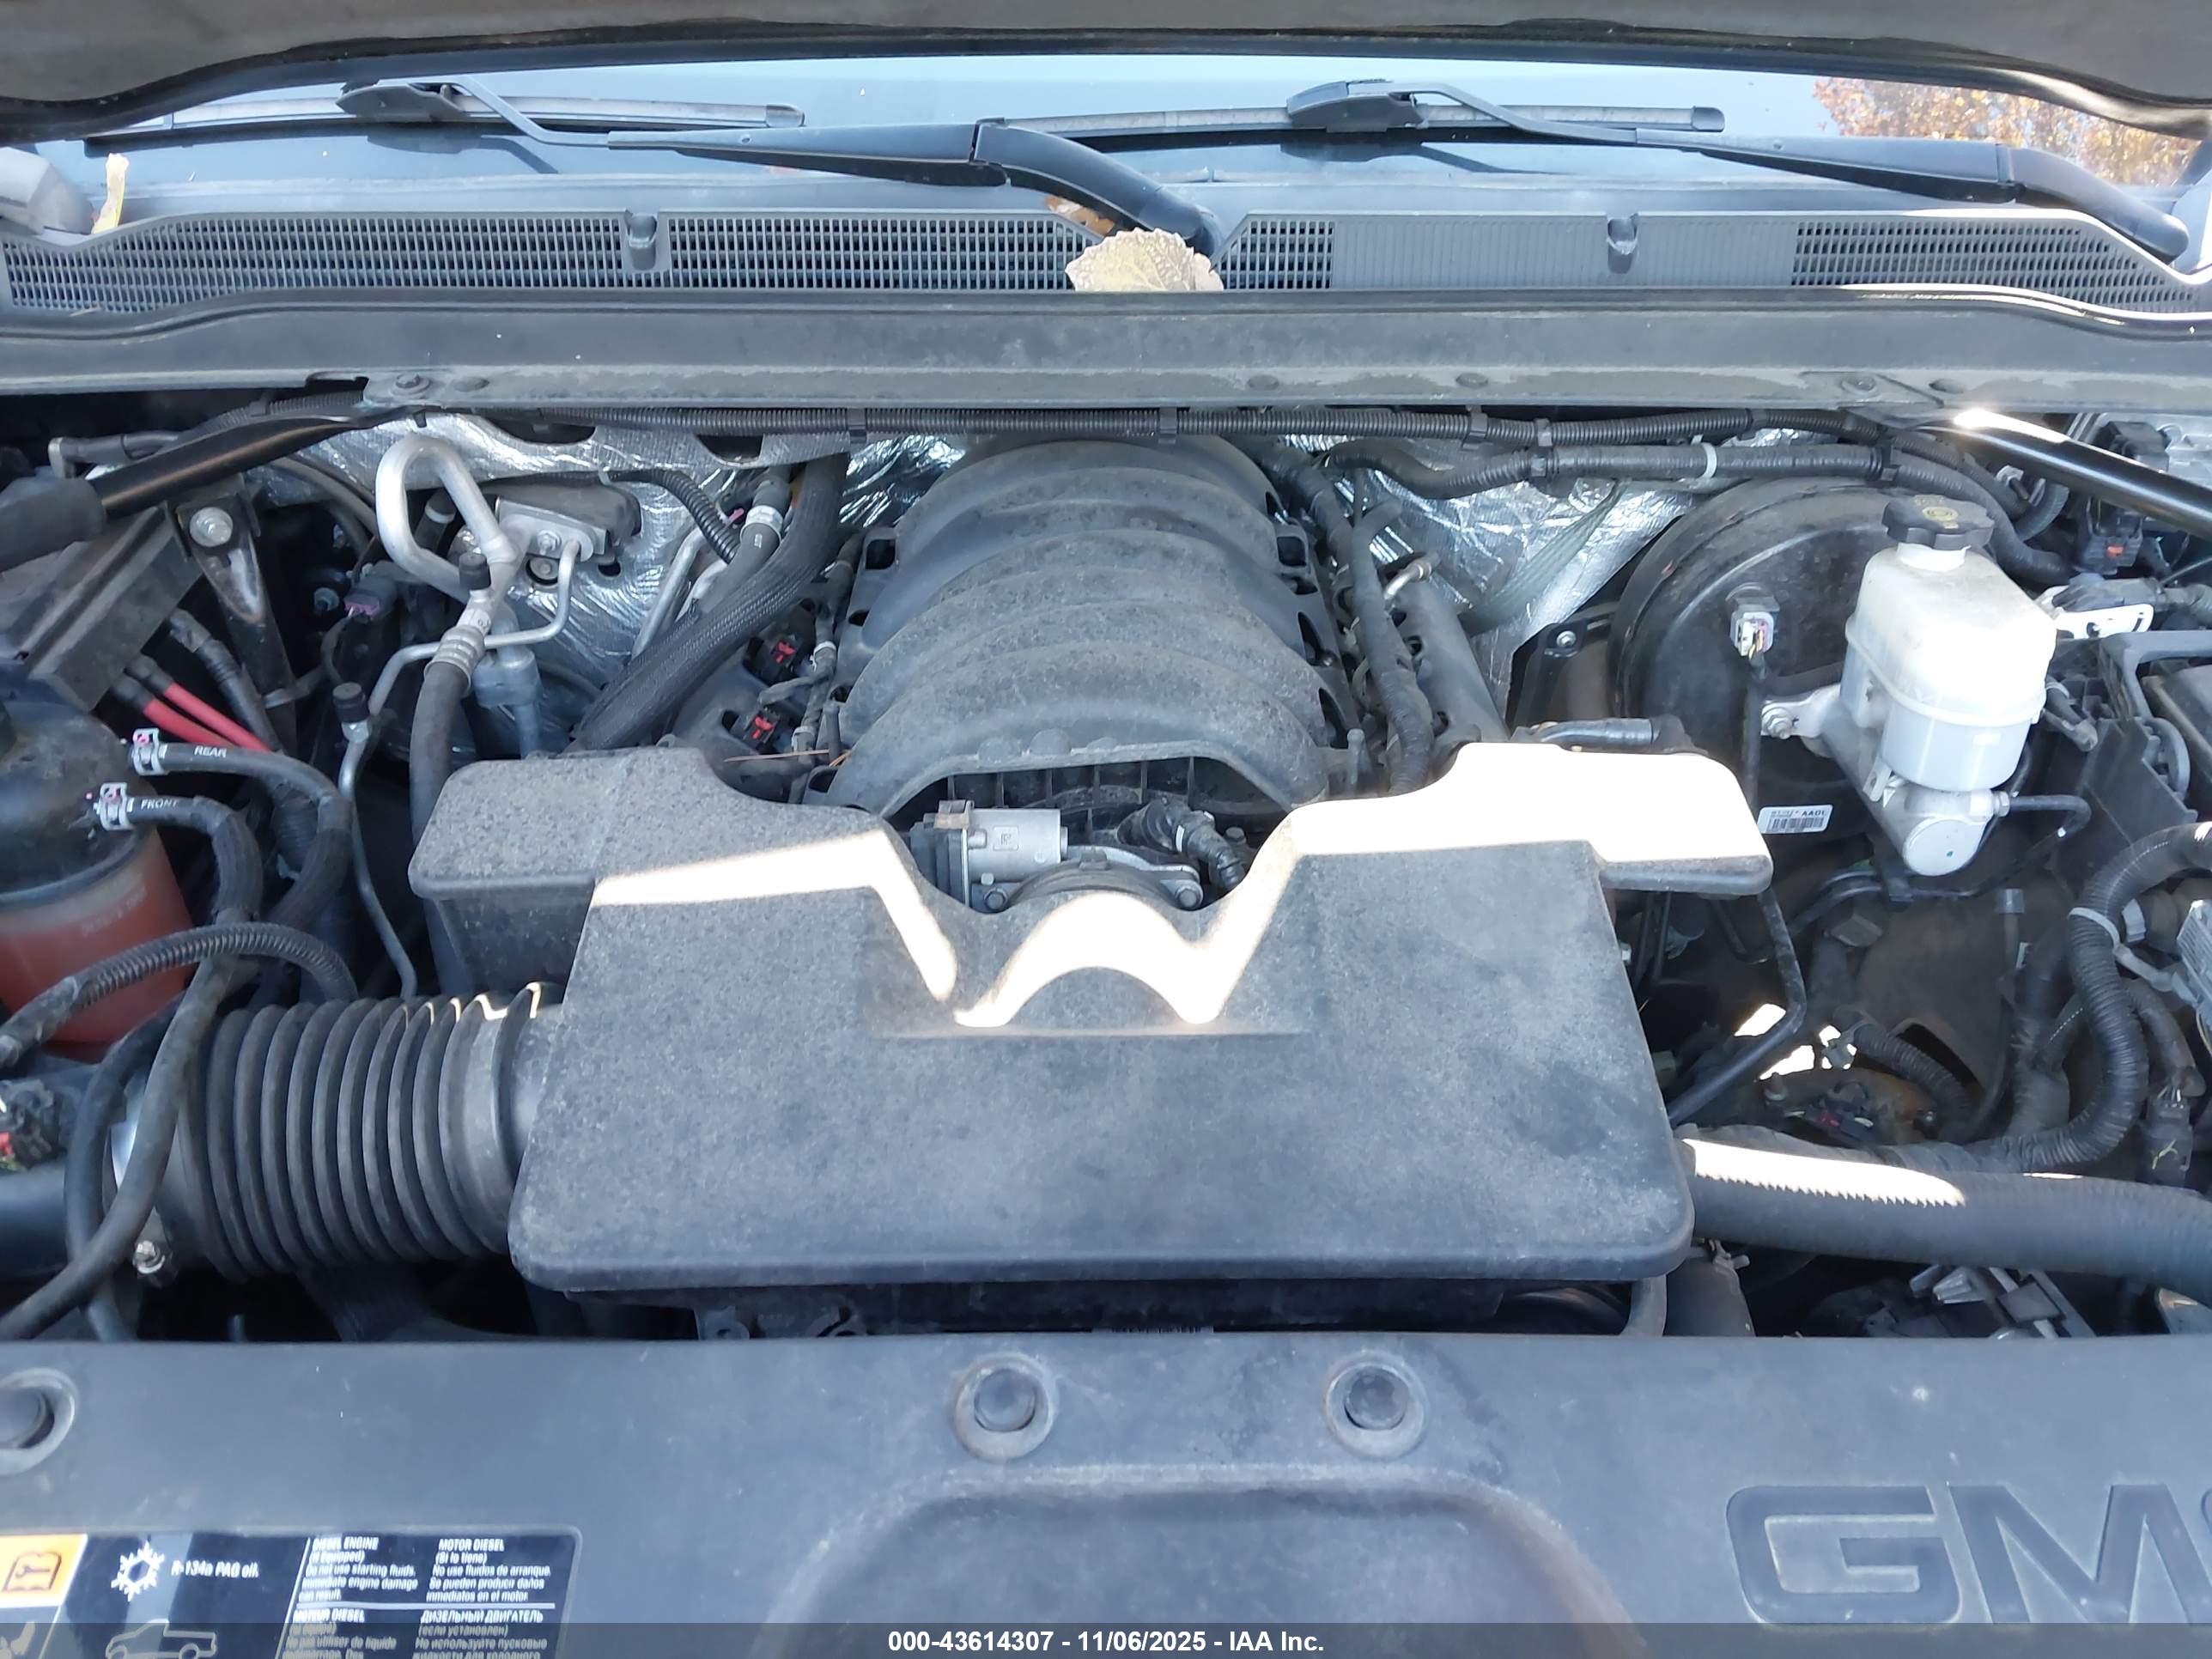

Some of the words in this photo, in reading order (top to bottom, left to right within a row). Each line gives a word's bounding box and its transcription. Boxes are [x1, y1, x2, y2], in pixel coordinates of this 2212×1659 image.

[195, 745, 227, 757] REAR
[141, 799, 179, 809] FRONT
[343, 1536, 379, 1550] ENGINE
[438, 1538, 472, 1552] MOTOR
[473, 1538, 505, 1552] DIESEL
[1726, 1484, 2212, 1628] GM
[171, 1559, 214, 1577] R-134a
[215, 1561, 240, 1578] PAG
[334, 1565, 350, 1575] use
[351, 1564, 388, 1578] starting
[433, 1565, 446, 1577] No
[447, 1565, 464, 1577] use
[465, 1565, 495, 1577] fluidos
[496, 1565, 508, 1577] de
[348, 1577, 380, 1591] engine
[381, 1578, 418, 1592] damage
[443, 1578, 477, 1591] pueden
[478, 1578, 515, 1591] producir
[477, 1591, 489, 1601] en
[490, 1590, 501, 1602] el
[331, 1608, 365, 1623] DIESEL
[484, 1609, 544, 1623] ДВИГАТЕЛЬ
[447, 1623, 508, 1638] установлен)
[317, 1636, 349, 1648] utiliser
[350, 1636, 363, 1648] de
[365, 1636, 397, 1651] liquide
